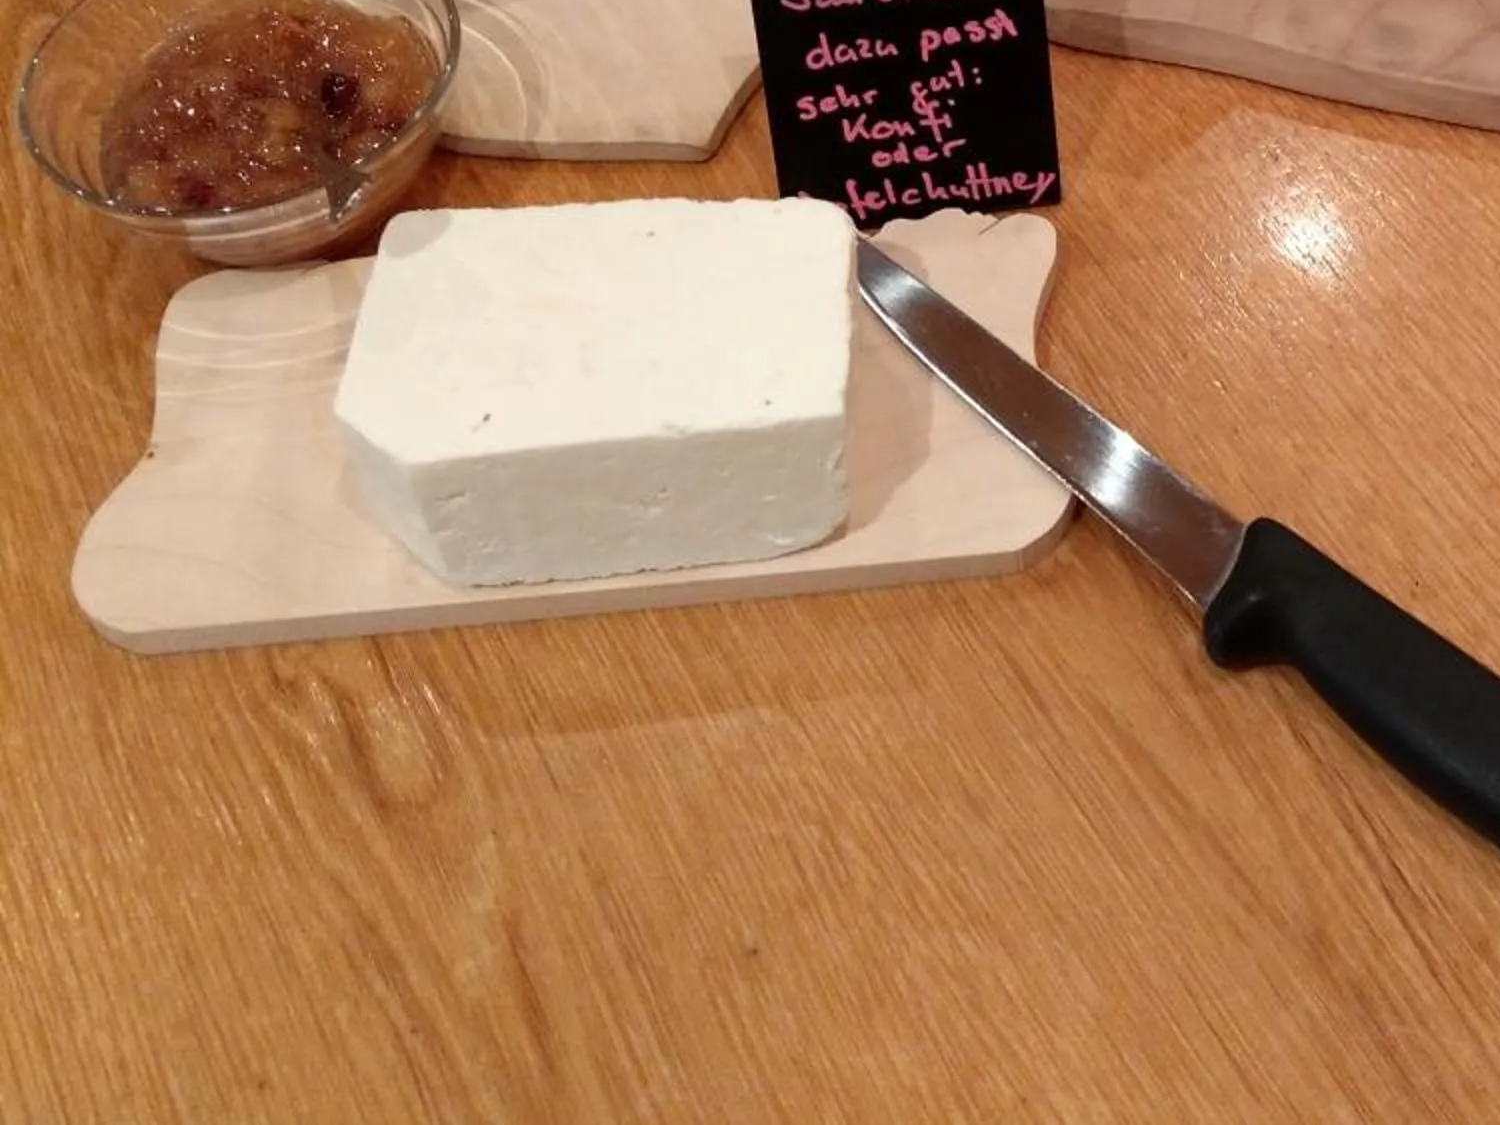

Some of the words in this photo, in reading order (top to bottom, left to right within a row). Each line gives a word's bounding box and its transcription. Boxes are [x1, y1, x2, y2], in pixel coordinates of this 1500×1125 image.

[805, 32, 900, 70] dazu
[796, 84, 879, 121] sehr
[871, 138, 967, 168] oder
[798, 161, 1056, 220] felchuttney
